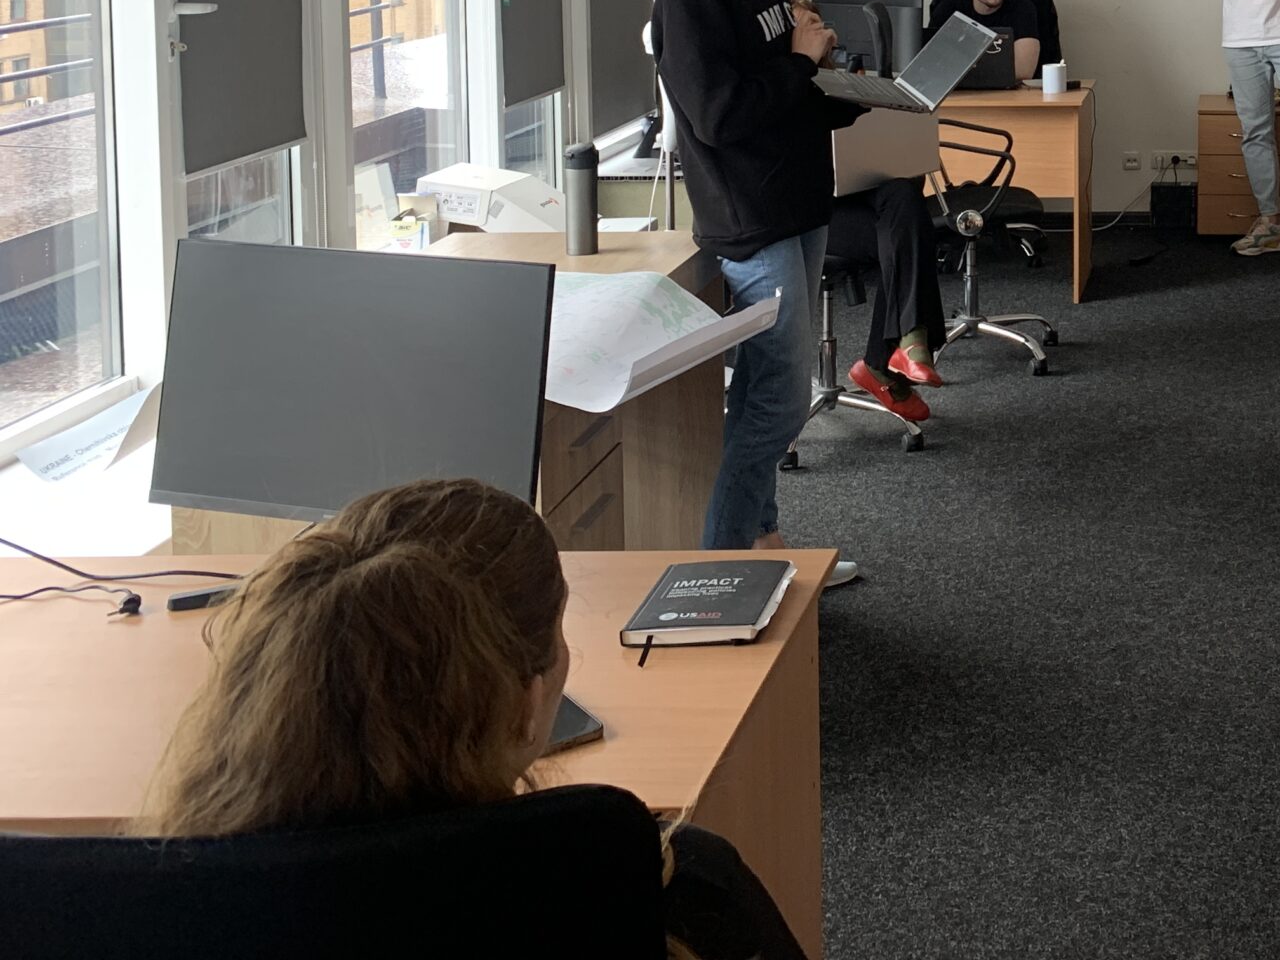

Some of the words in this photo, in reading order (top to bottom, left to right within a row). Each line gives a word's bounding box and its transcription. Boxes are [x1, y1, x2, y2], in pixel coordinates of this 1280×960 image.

[756, 1, 798, 42] IMPC
[40, 453, 73, 474] UKRAINE
[673, 577, 744, 588] IMPACT
